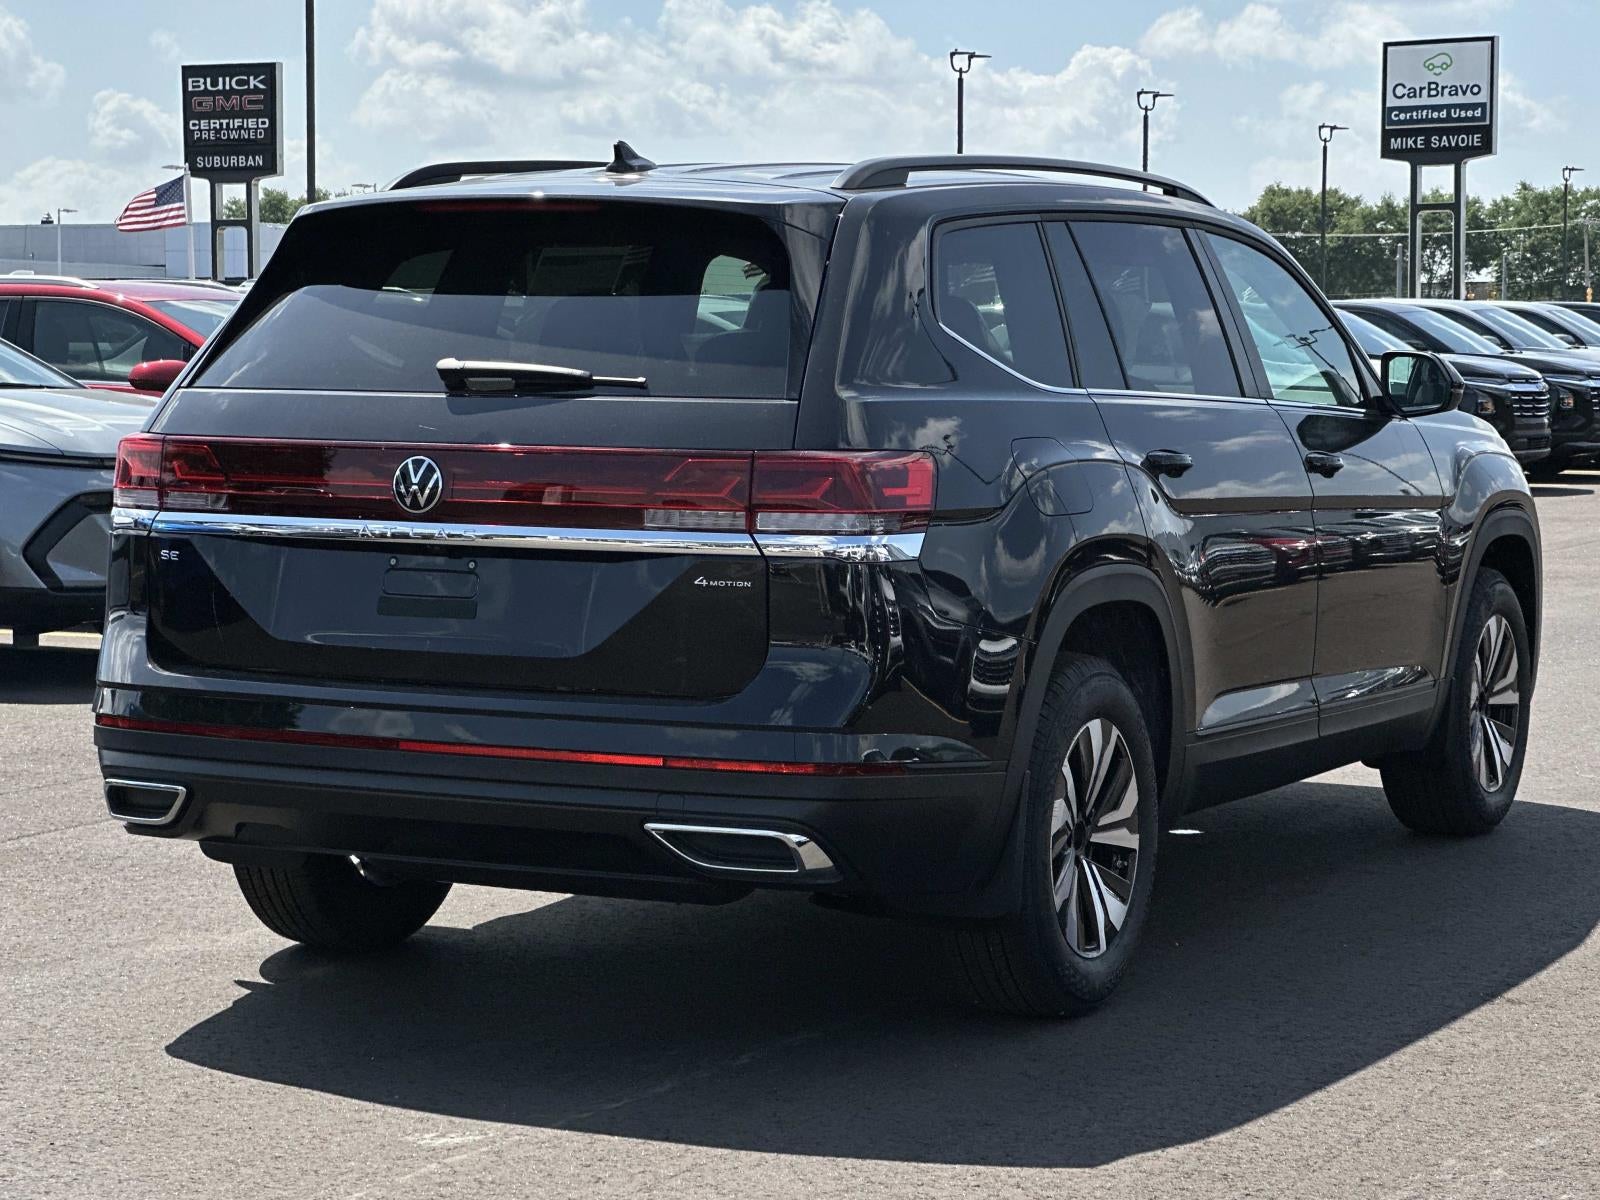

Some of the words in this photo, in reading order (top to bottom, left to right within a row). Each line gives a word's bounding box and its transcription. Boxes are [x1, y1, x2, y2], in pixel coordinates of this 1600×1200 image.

[187, 75, 267, 91] BUICK
[1392, 82, 1482, 99] CarBravo
[191, 95, 264, 112] GMC
[1391, 109, 1447, 120] Certified
[1450, 107, 1482, 118] Used
[189, 118, 269, 130] CERTIFIED
[194, 129, 265, 140] PRE-OWNED
[1390, 136, 1426, 150] MIKE
[1430, 134, 1482, 148] SAVOIE
[196, 155, 263, 168] SUBURBAN
[359, 524, 476, 541] ATLAS
[160, 549, 180, 561] SE
